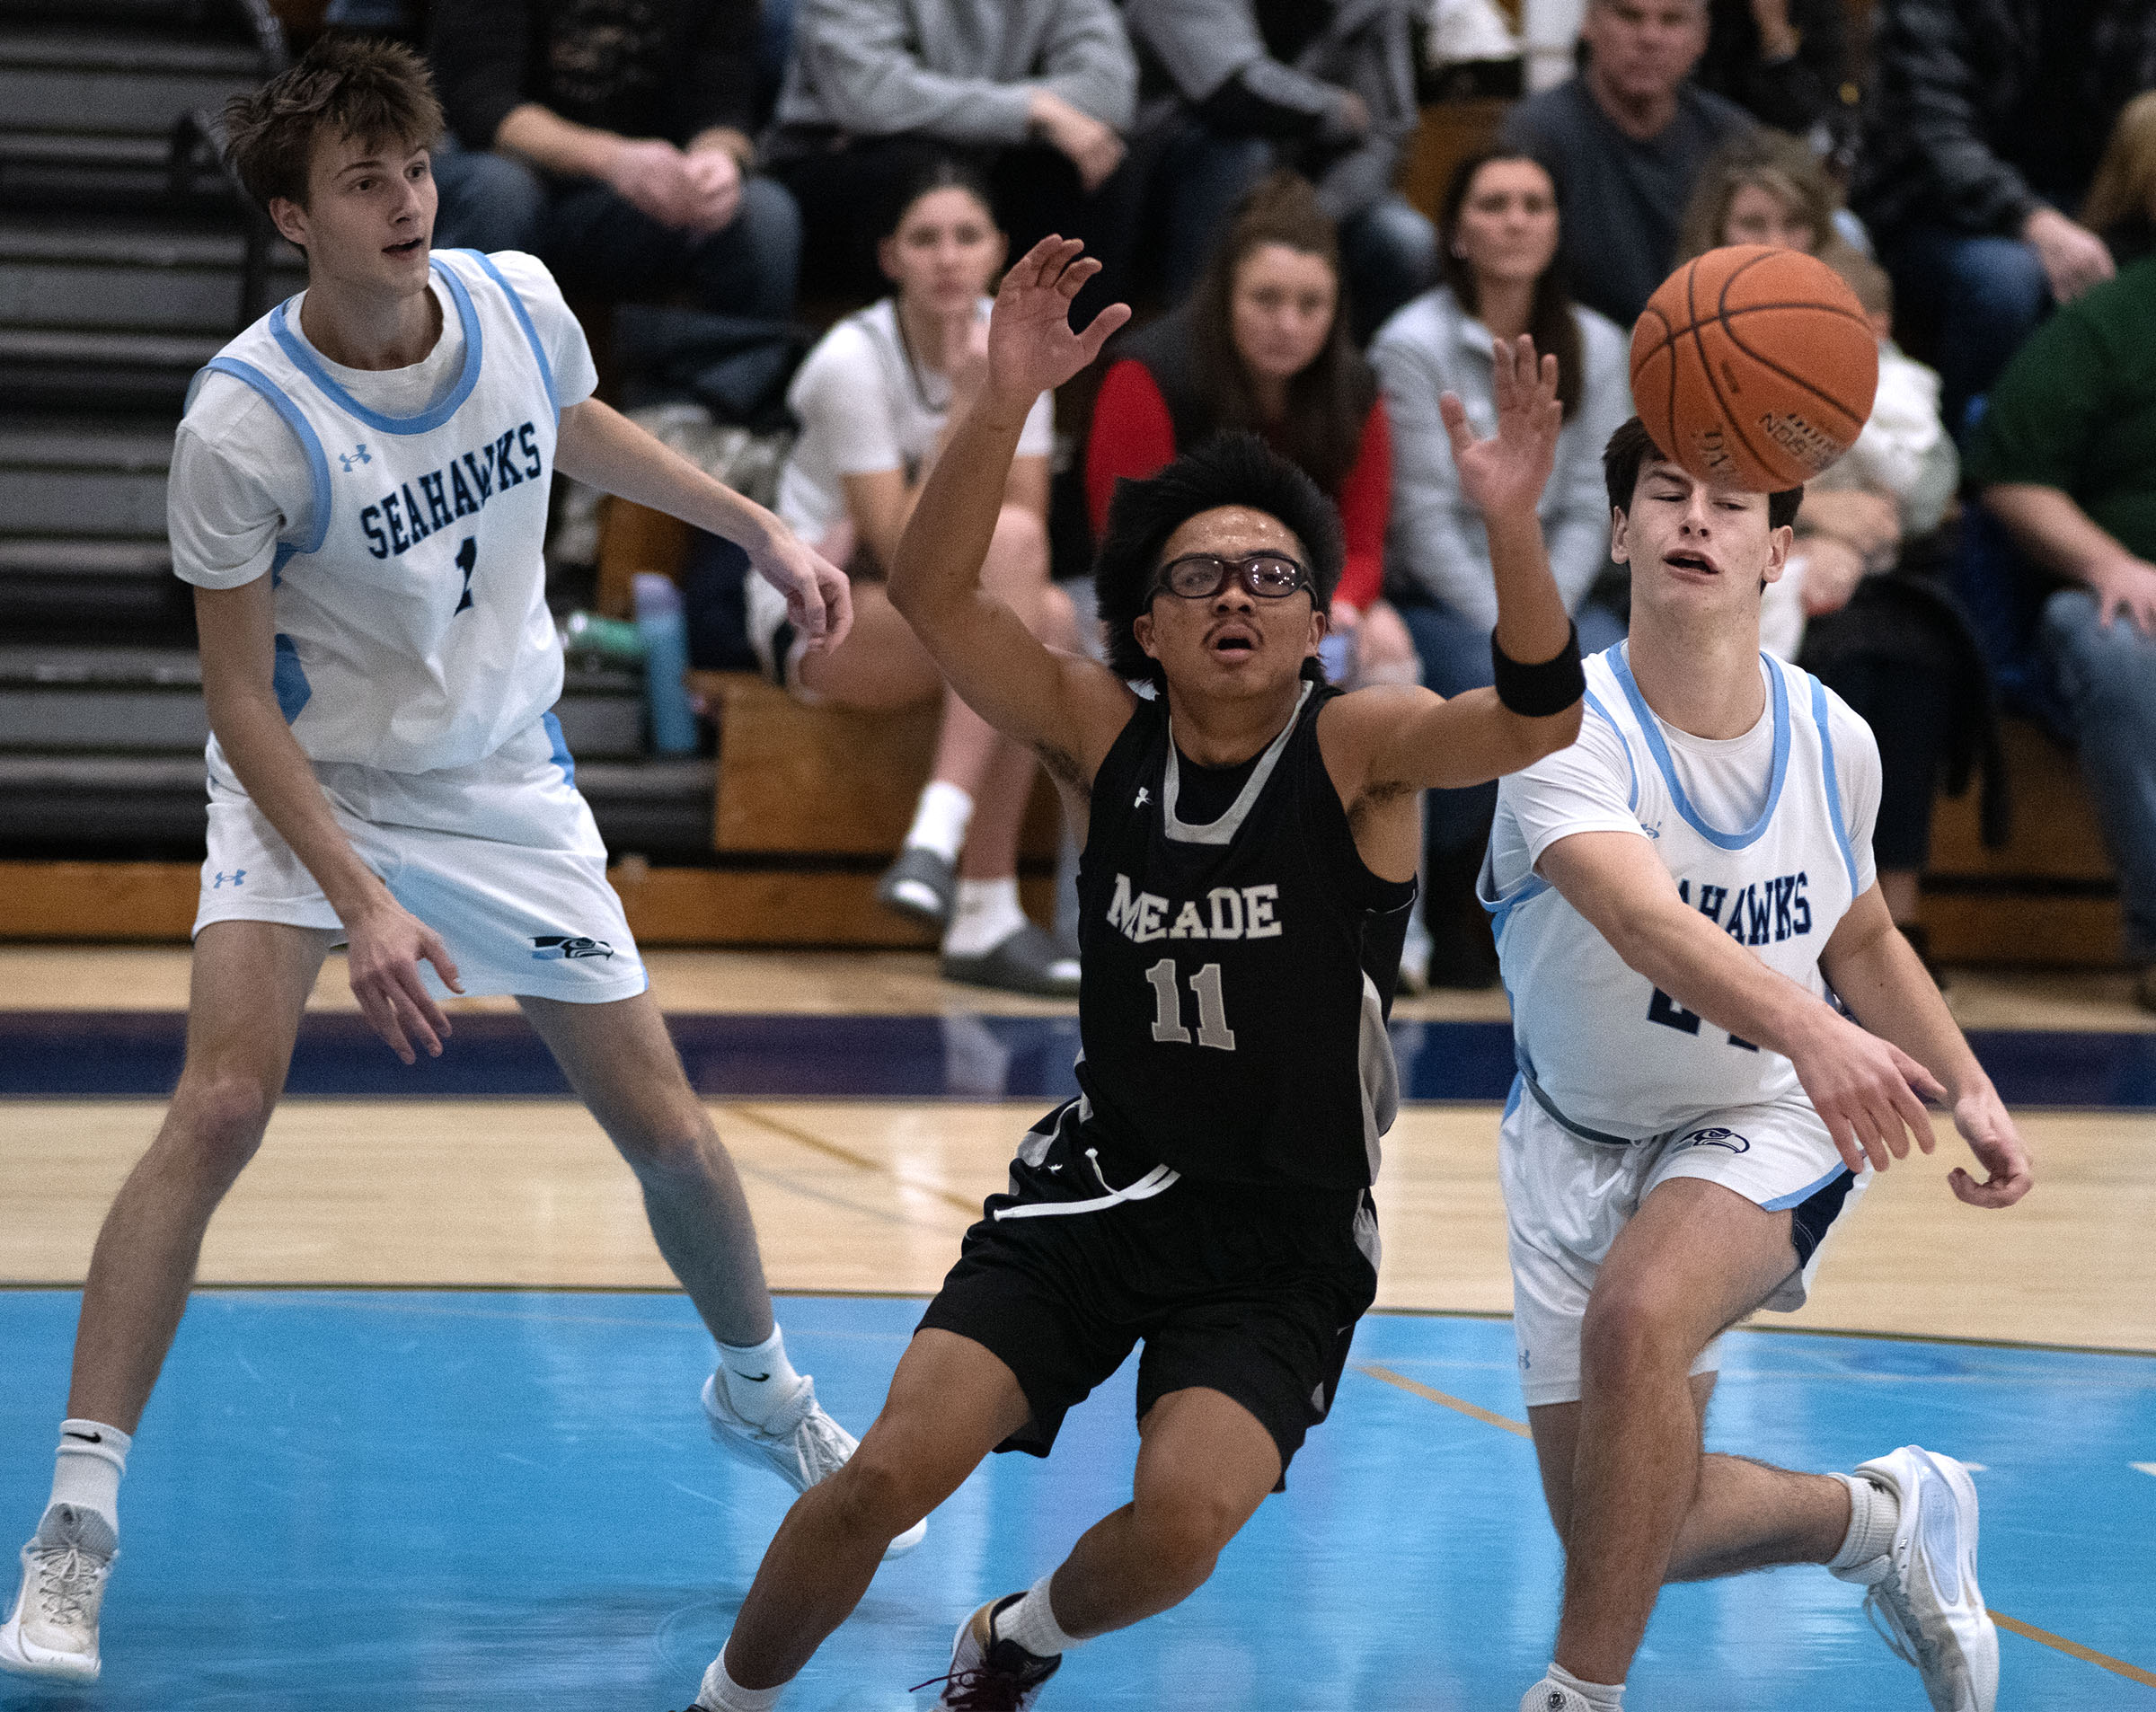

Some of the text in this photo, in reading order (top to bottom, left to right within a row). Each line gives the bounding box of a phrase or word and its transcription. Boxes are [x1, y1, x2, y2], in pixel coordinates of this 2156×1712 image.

[360, 421, 542, 560] SEAHAWKS
[453, 534, 478, 618] 1
[1106, 872, 1283, 943] MEADE
[1145, 957, 1236, 1051] 11
